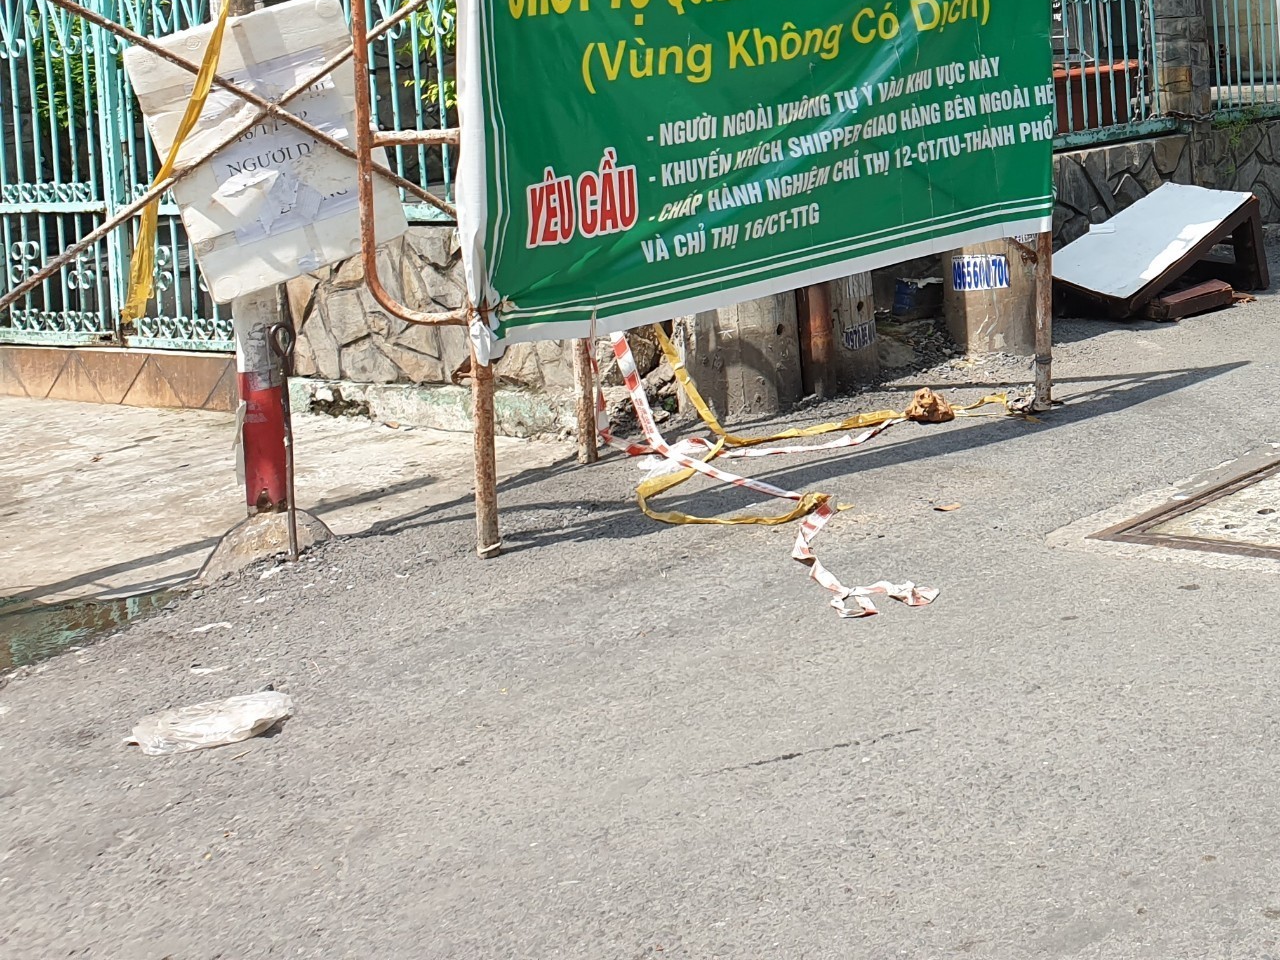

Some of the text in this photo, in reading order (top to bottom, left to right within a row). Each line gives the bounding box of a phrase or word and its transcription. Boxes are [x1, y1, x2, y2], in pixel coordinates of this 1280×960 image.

[581, 26, 713, 94] (Vùng
[728, 20, 843, 69] Không
[850, 1, 900, 46] Có
[659, 111, 717, 147] NGƯỜI
[722, 103, 773, 138] NGOÀI
[777, 89, 831, 126] KHÔNG
[834, 86, 859, 114] TỰ
[860, 81, 874, 108] Ý
[878, 76, 905, 104] VÀO
[905, 67, 932, 95] KHU
[935, 61, 965, 90] VỰC
[969, 53, 1001, 81] NÀY
[661, 148, 732, 187] KHUYẾN
[733, 139, 784, 171] KHÍCH
[789, 123, 862, 160] SHIPPER
[862, 115, 897, 140] GIAO
[900, 102, 941, 131] HÀNG
[944, 94, 977, 122] BÊN
[980, 84, 1030, 115] NGOÀI
[527, 149, 638, 248] YÊU CẦU
[658, 190, 703, 223] CHẤP
[708, 180, 763, 212] HÀNH
[767, 164, 831, 201] NGHIỆM
[832, 150, 861, 182] CHỈ
[863, 151, 890, 177] THỊ
[1020, 112, 1054, 144] PHỐ
[641, 202, 820, 263] VÀ CHỈ THỊ 16/CT-TTG
